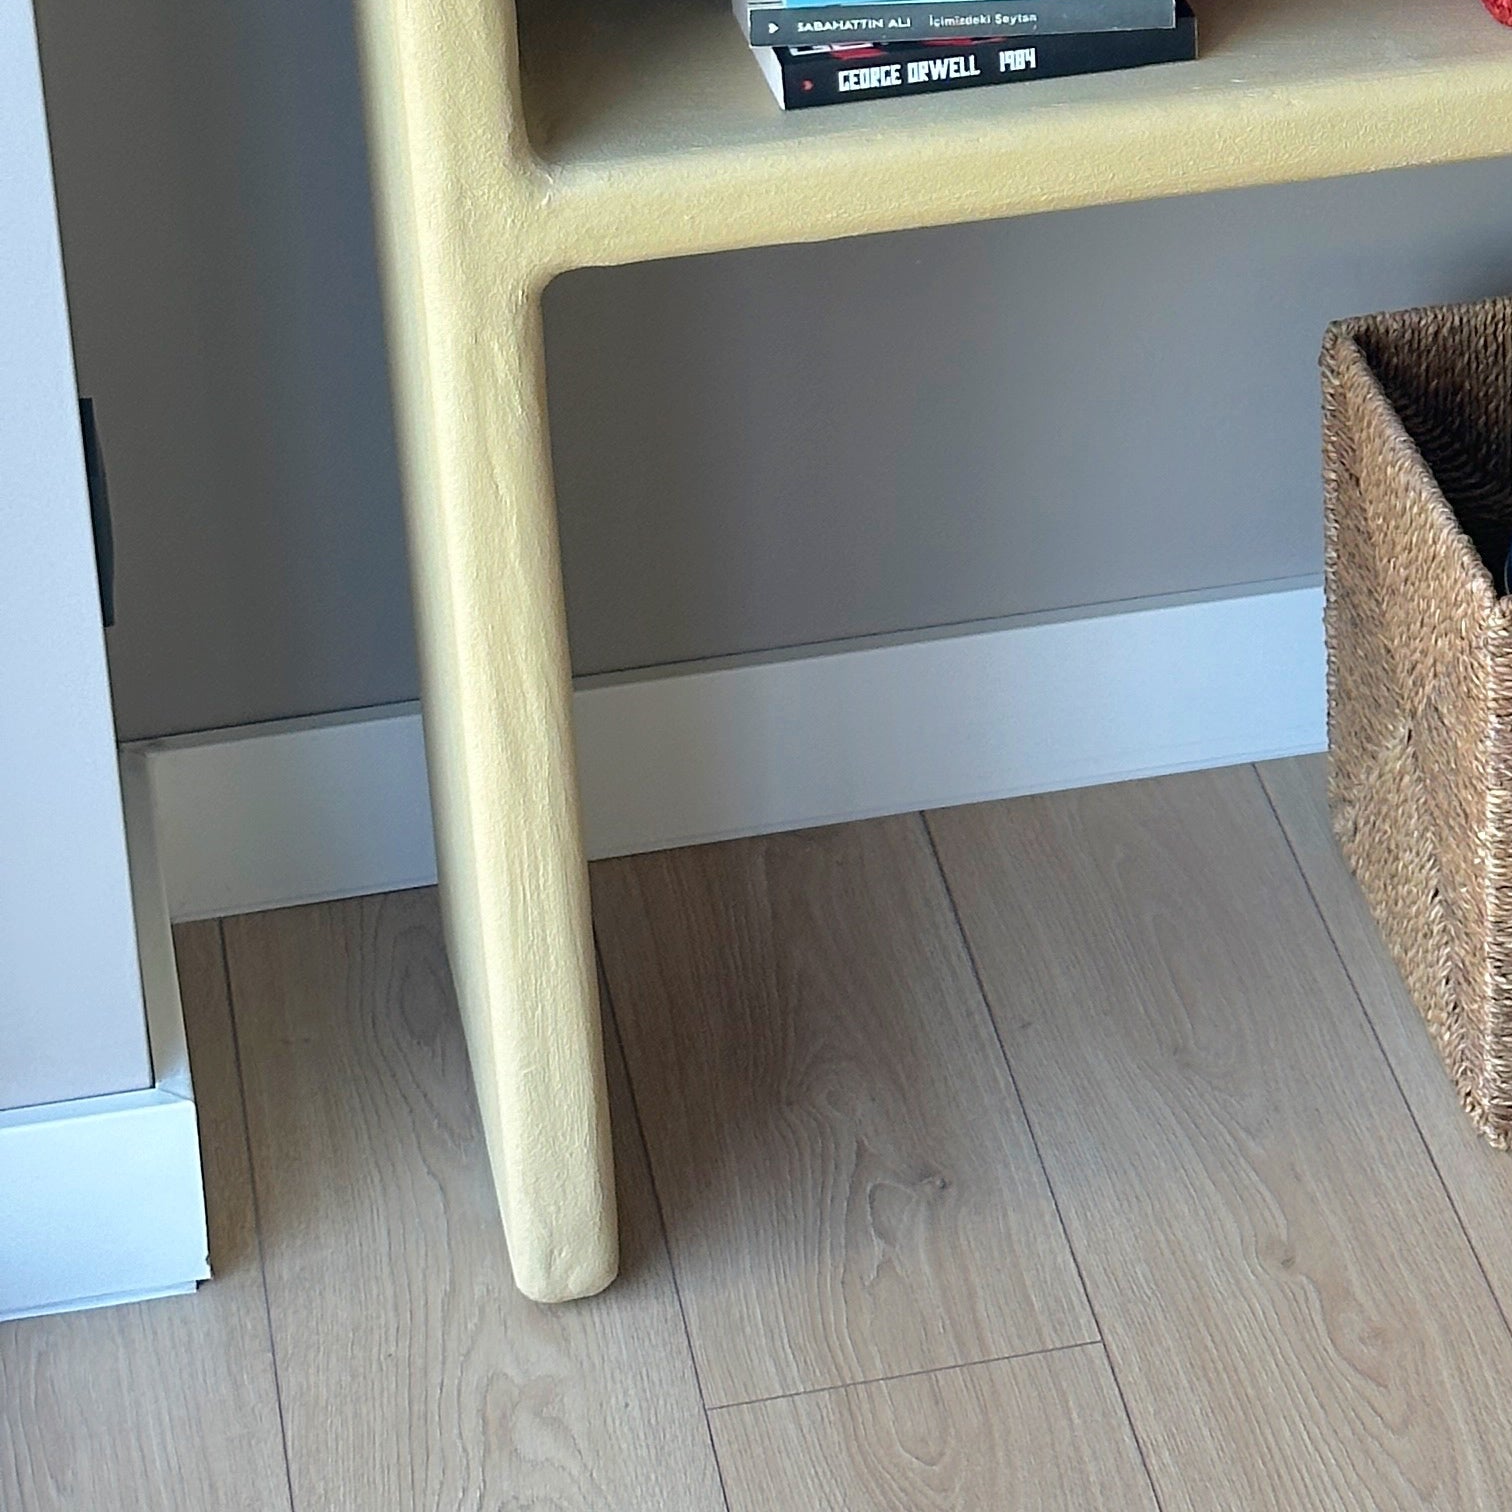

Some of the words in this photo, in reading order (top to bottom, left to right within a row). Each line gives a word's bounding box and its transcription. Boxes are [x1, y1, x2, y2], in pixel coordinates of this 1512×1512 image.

[797, 18, 884, 33] SABAHATTIN
[888, 17, 911, 28] ALI
[838, 63, 902, 93] GEORGE
[907, 54, 981, 85] ORWELL
[999, 47, 1037, 73] 1984
